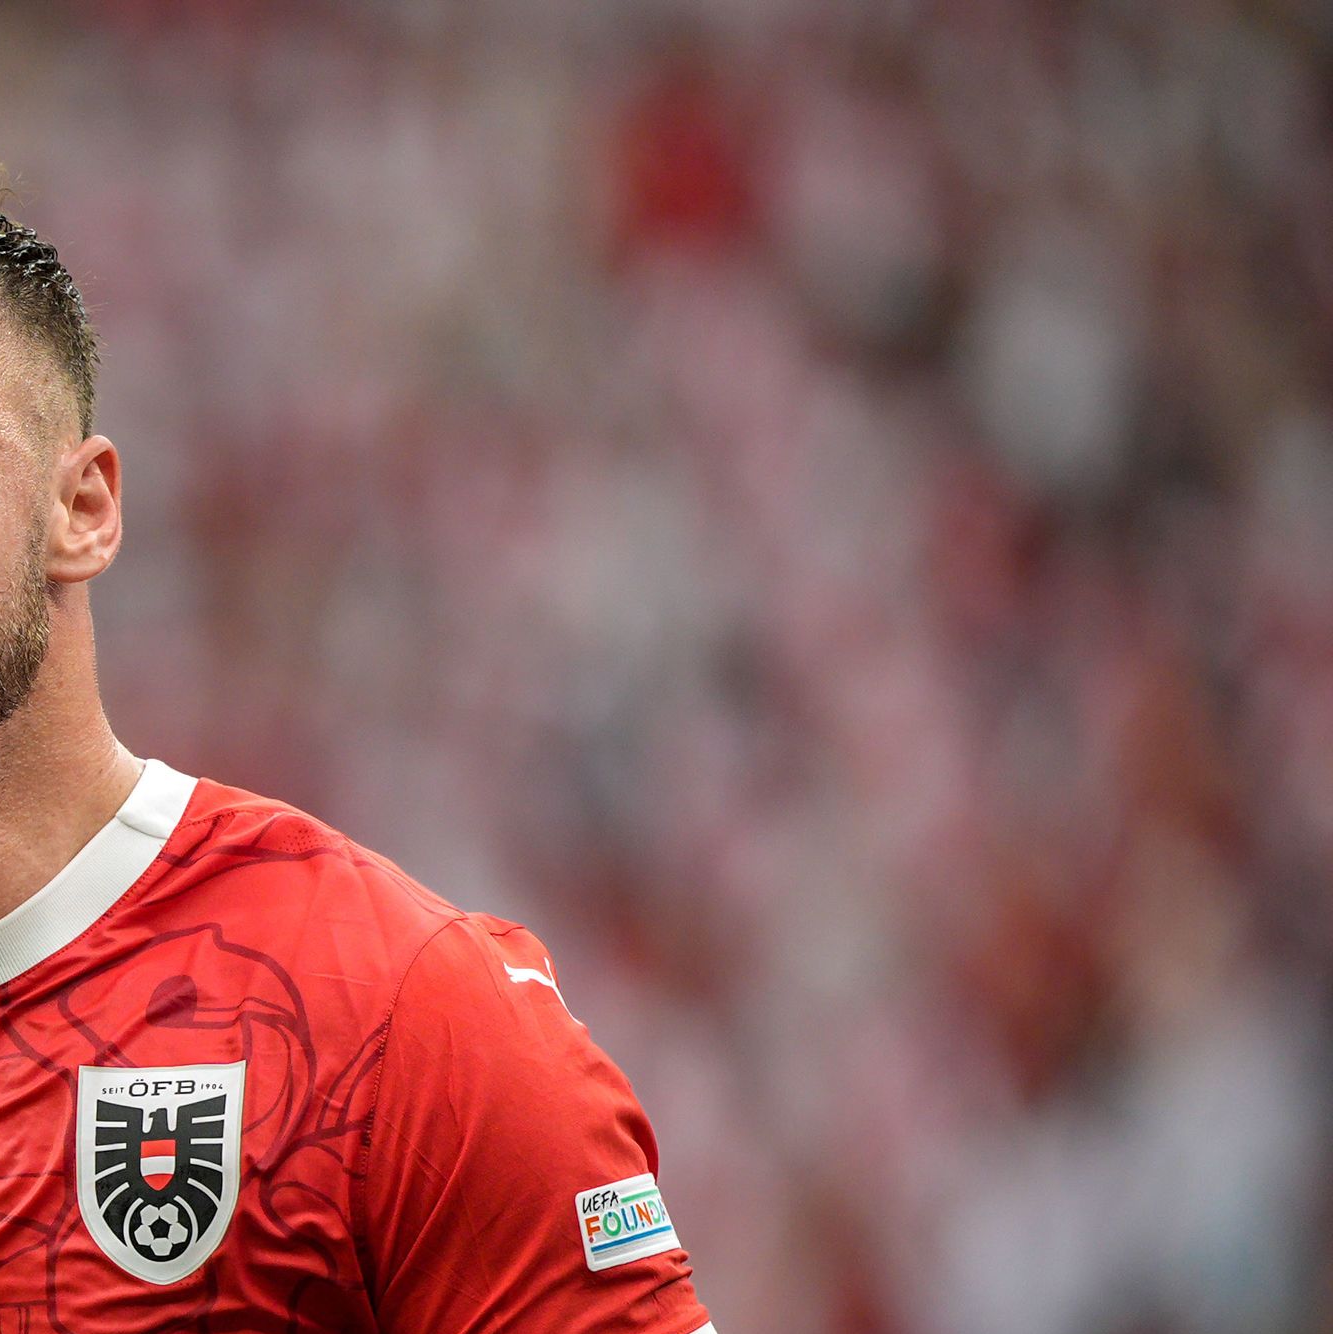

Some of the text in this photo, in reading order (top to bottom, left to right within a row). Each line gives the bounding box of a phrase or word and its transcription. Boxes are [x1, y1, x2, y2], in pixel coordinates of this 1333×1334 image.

[101, 1087, 124, 1095] SEIT
[128, 1078, 196, 1097] ÖFB
[582, 1190, 619, 1214] UEFA
